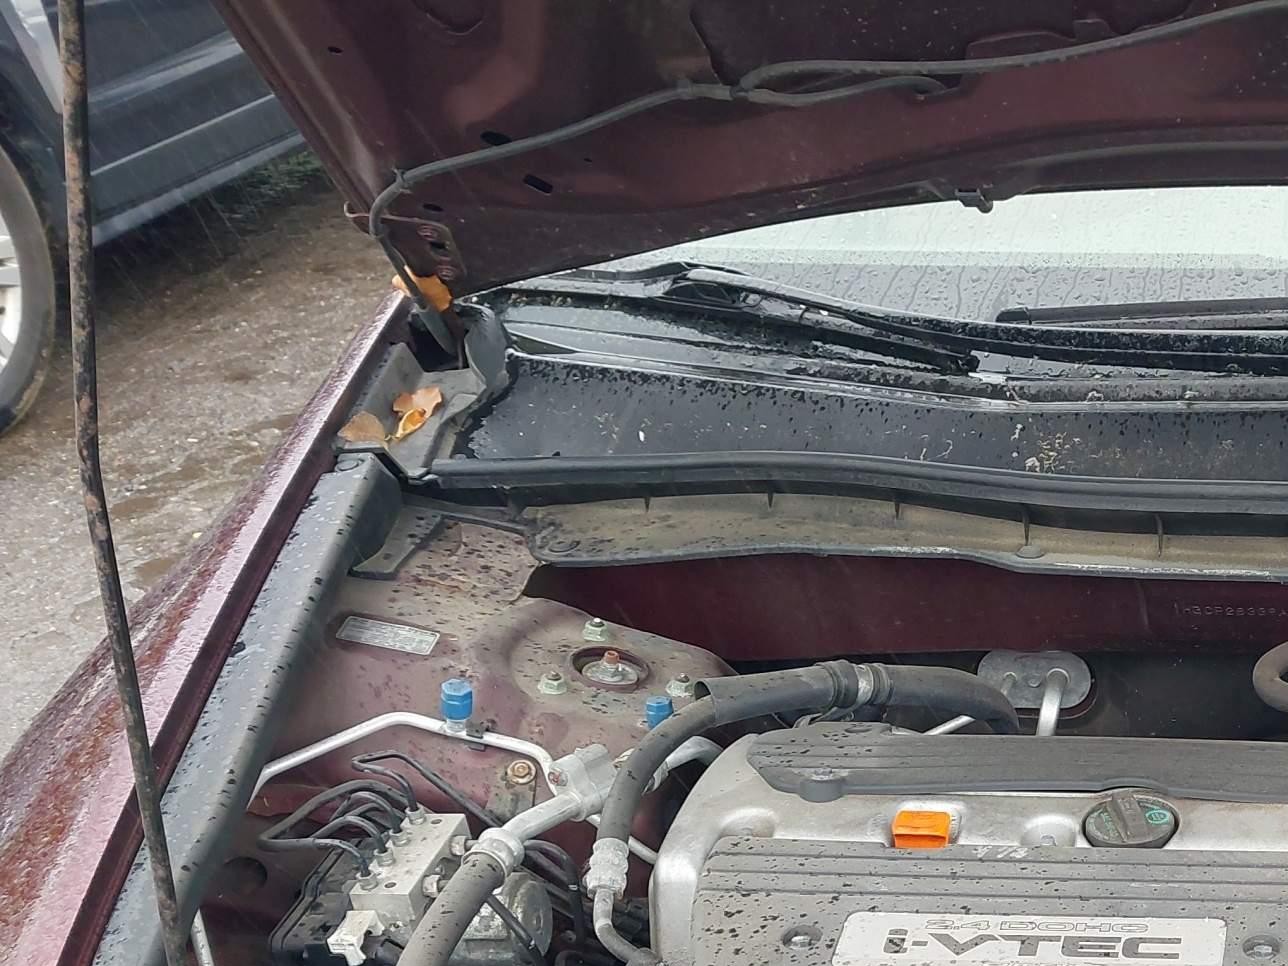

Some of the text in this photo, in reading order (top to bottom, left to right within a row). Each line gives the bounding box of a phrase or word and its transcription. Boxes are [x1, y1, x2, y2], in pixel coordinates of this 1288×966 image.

[924, 918, 1150, 934] 2.4 DOHC
[884, 927, 1182, 960] i-VTEC
